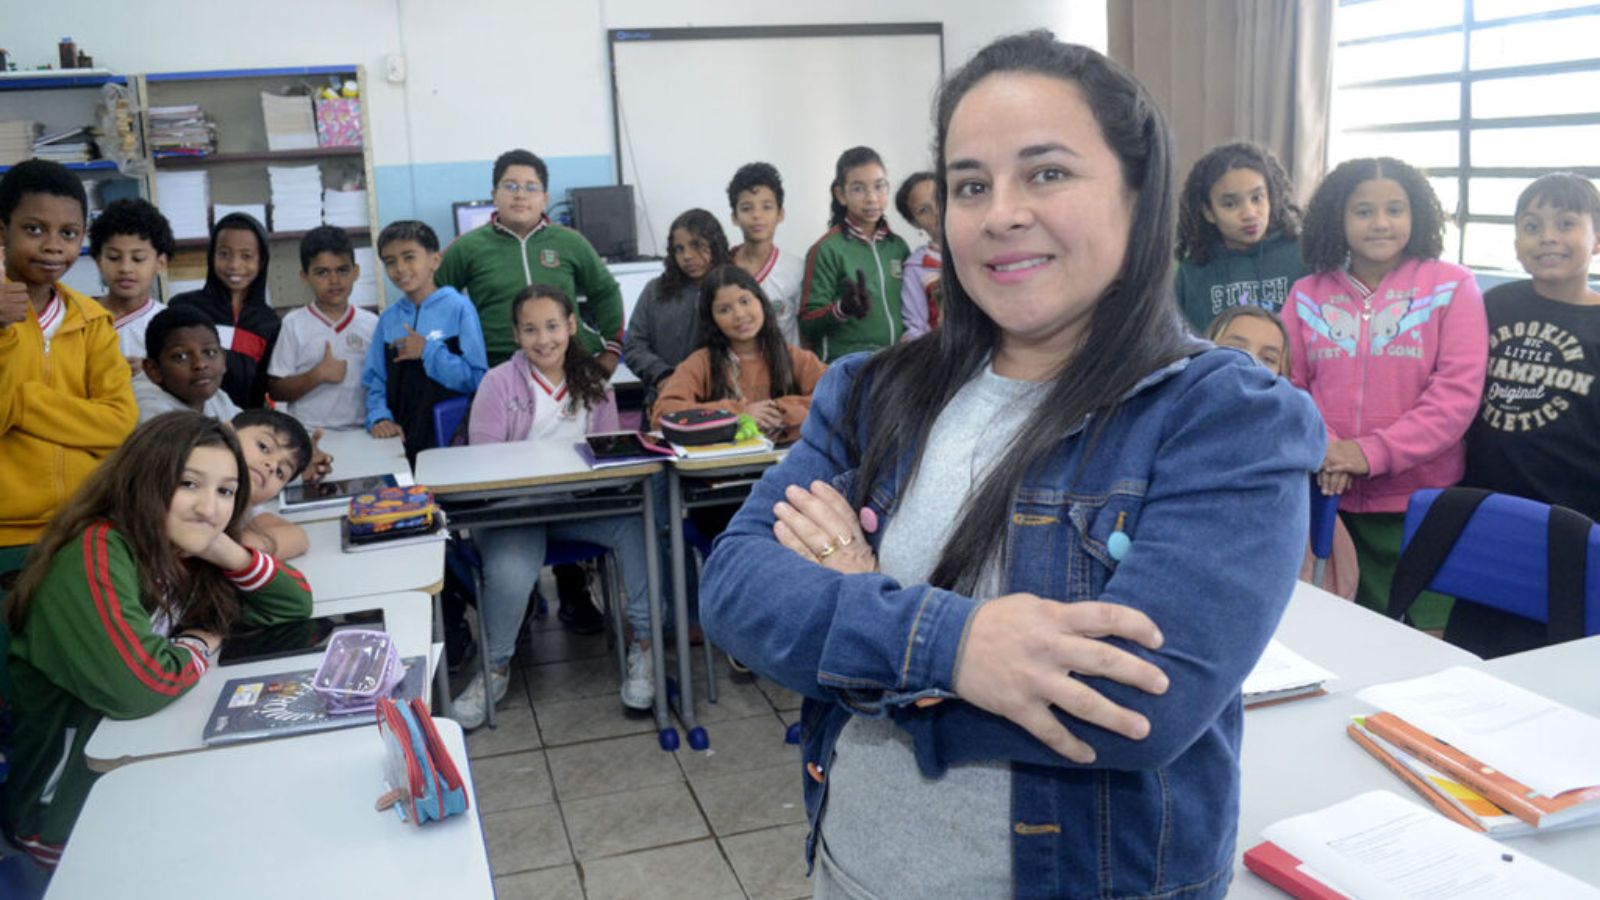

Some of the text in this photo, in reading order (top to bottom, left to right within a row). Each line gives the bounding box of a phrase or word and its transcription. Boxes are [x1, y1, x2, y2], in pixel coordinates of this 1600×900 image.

[1211, 276, 1287, 315] STITCH
[1504, 345, 1553, 363] LITTLE
[1488, 357, 1595, 396] AMPION
[1488, 382, 1546, 404] Original
